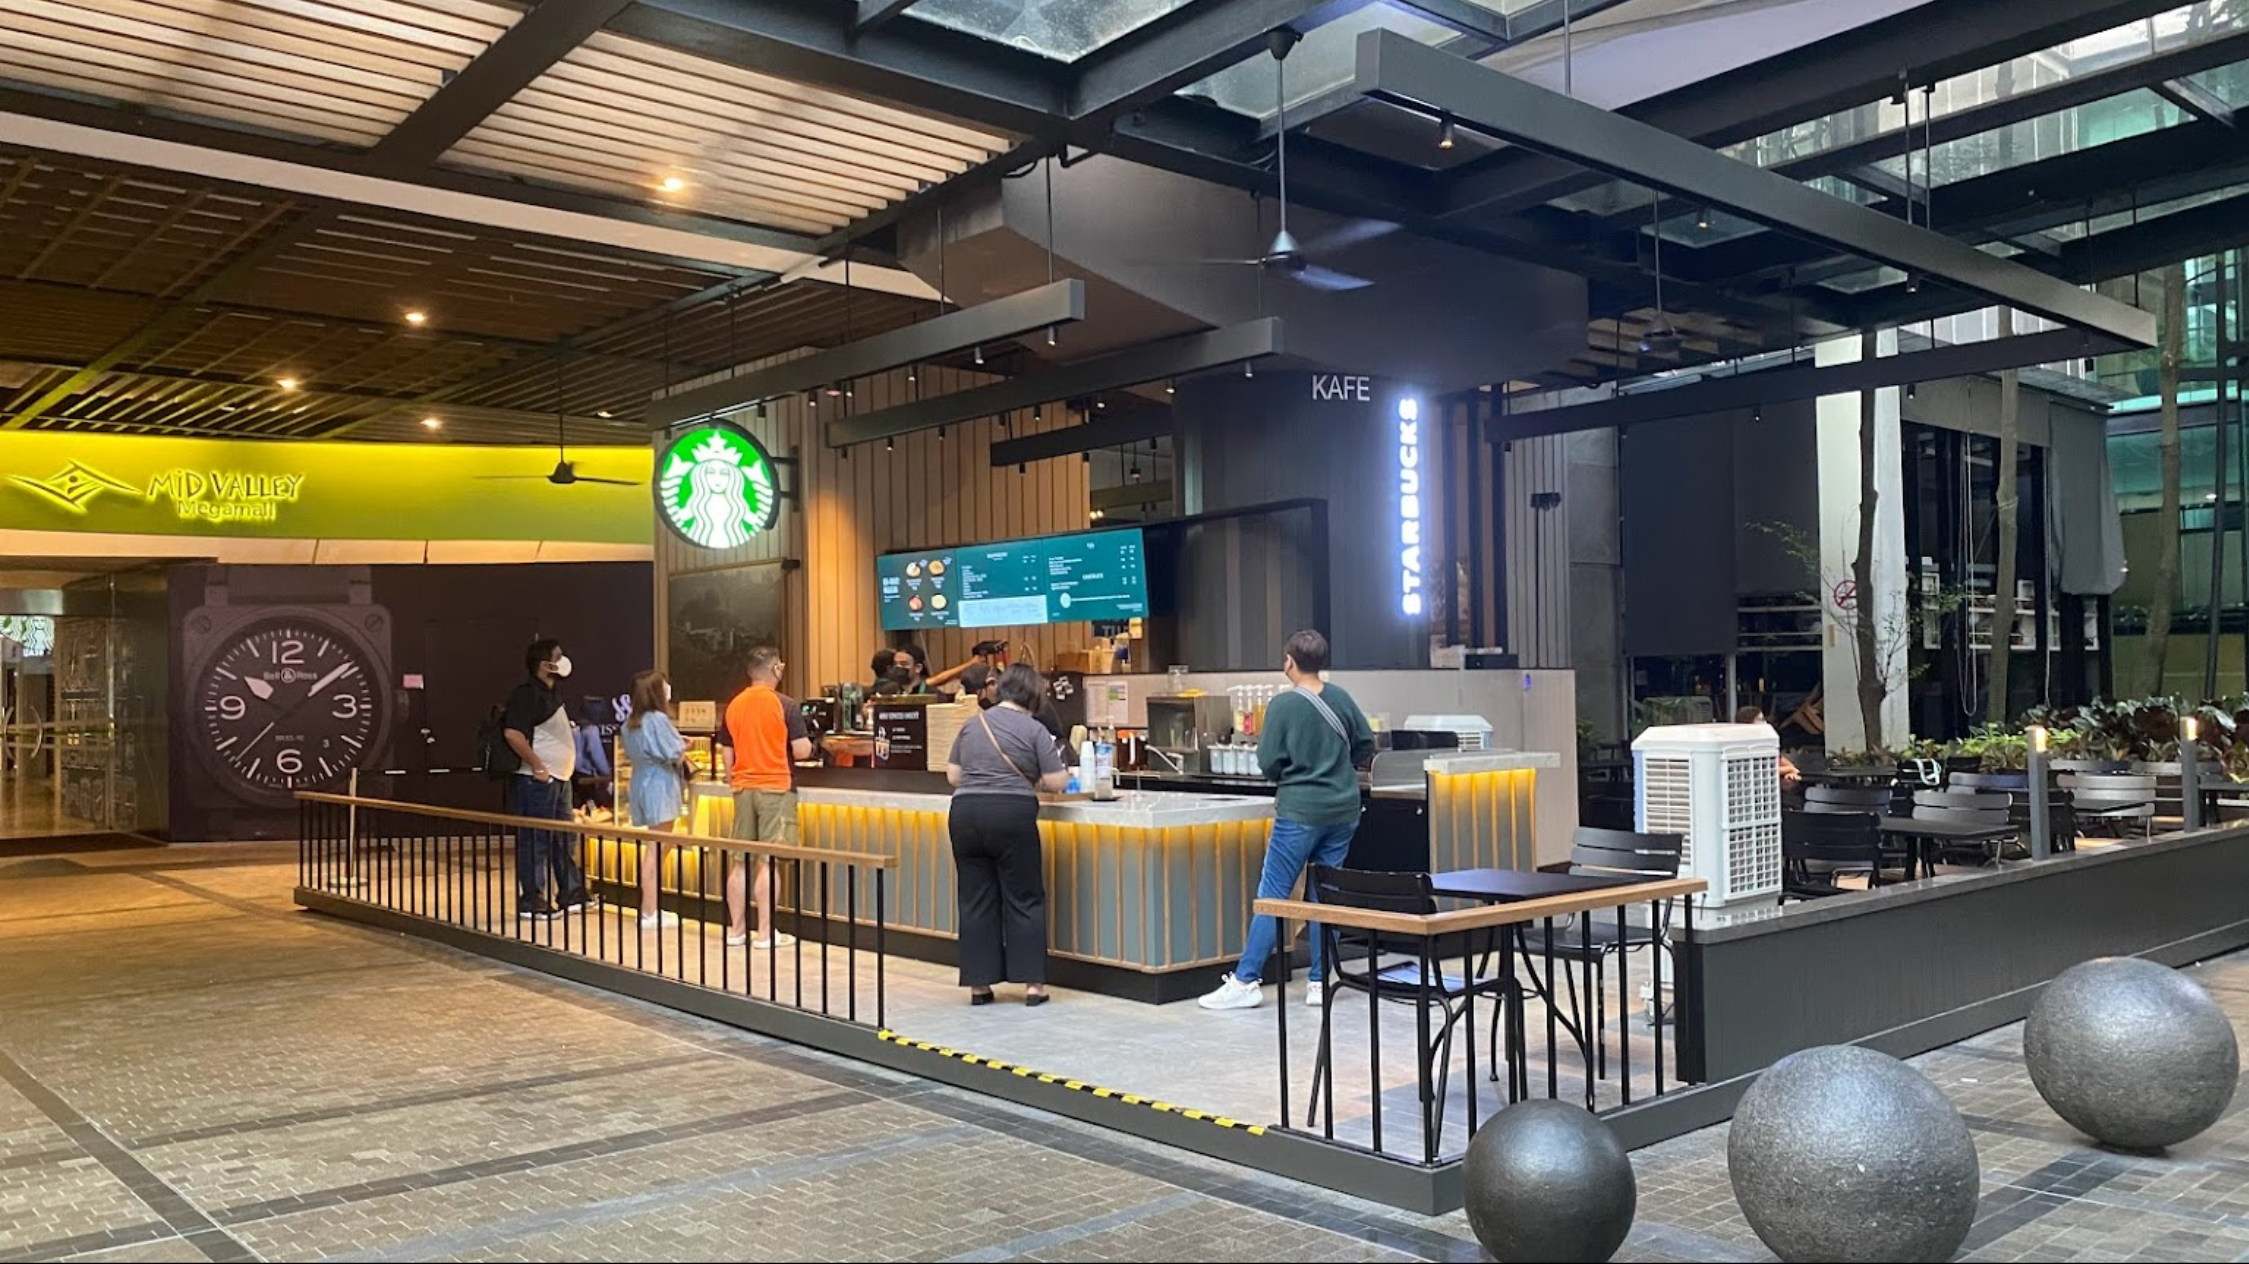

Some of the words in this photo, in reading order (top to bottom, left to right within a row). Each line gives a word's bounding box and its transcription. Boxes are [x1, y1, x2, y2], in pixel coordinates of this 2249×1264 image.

[1312, 375, 1370, 401] KAFE
[211, 471, 303, 498] VALLEY
[177, 500, 277, 520] Megamall
[1399, 398, 1422, 616] STARBUCKS
[272, 640, 305, 664] 12
[220, 695, 246, 720] 9
[332, 694, 358, 719] 3
[277, 748, 303, 774] 6
